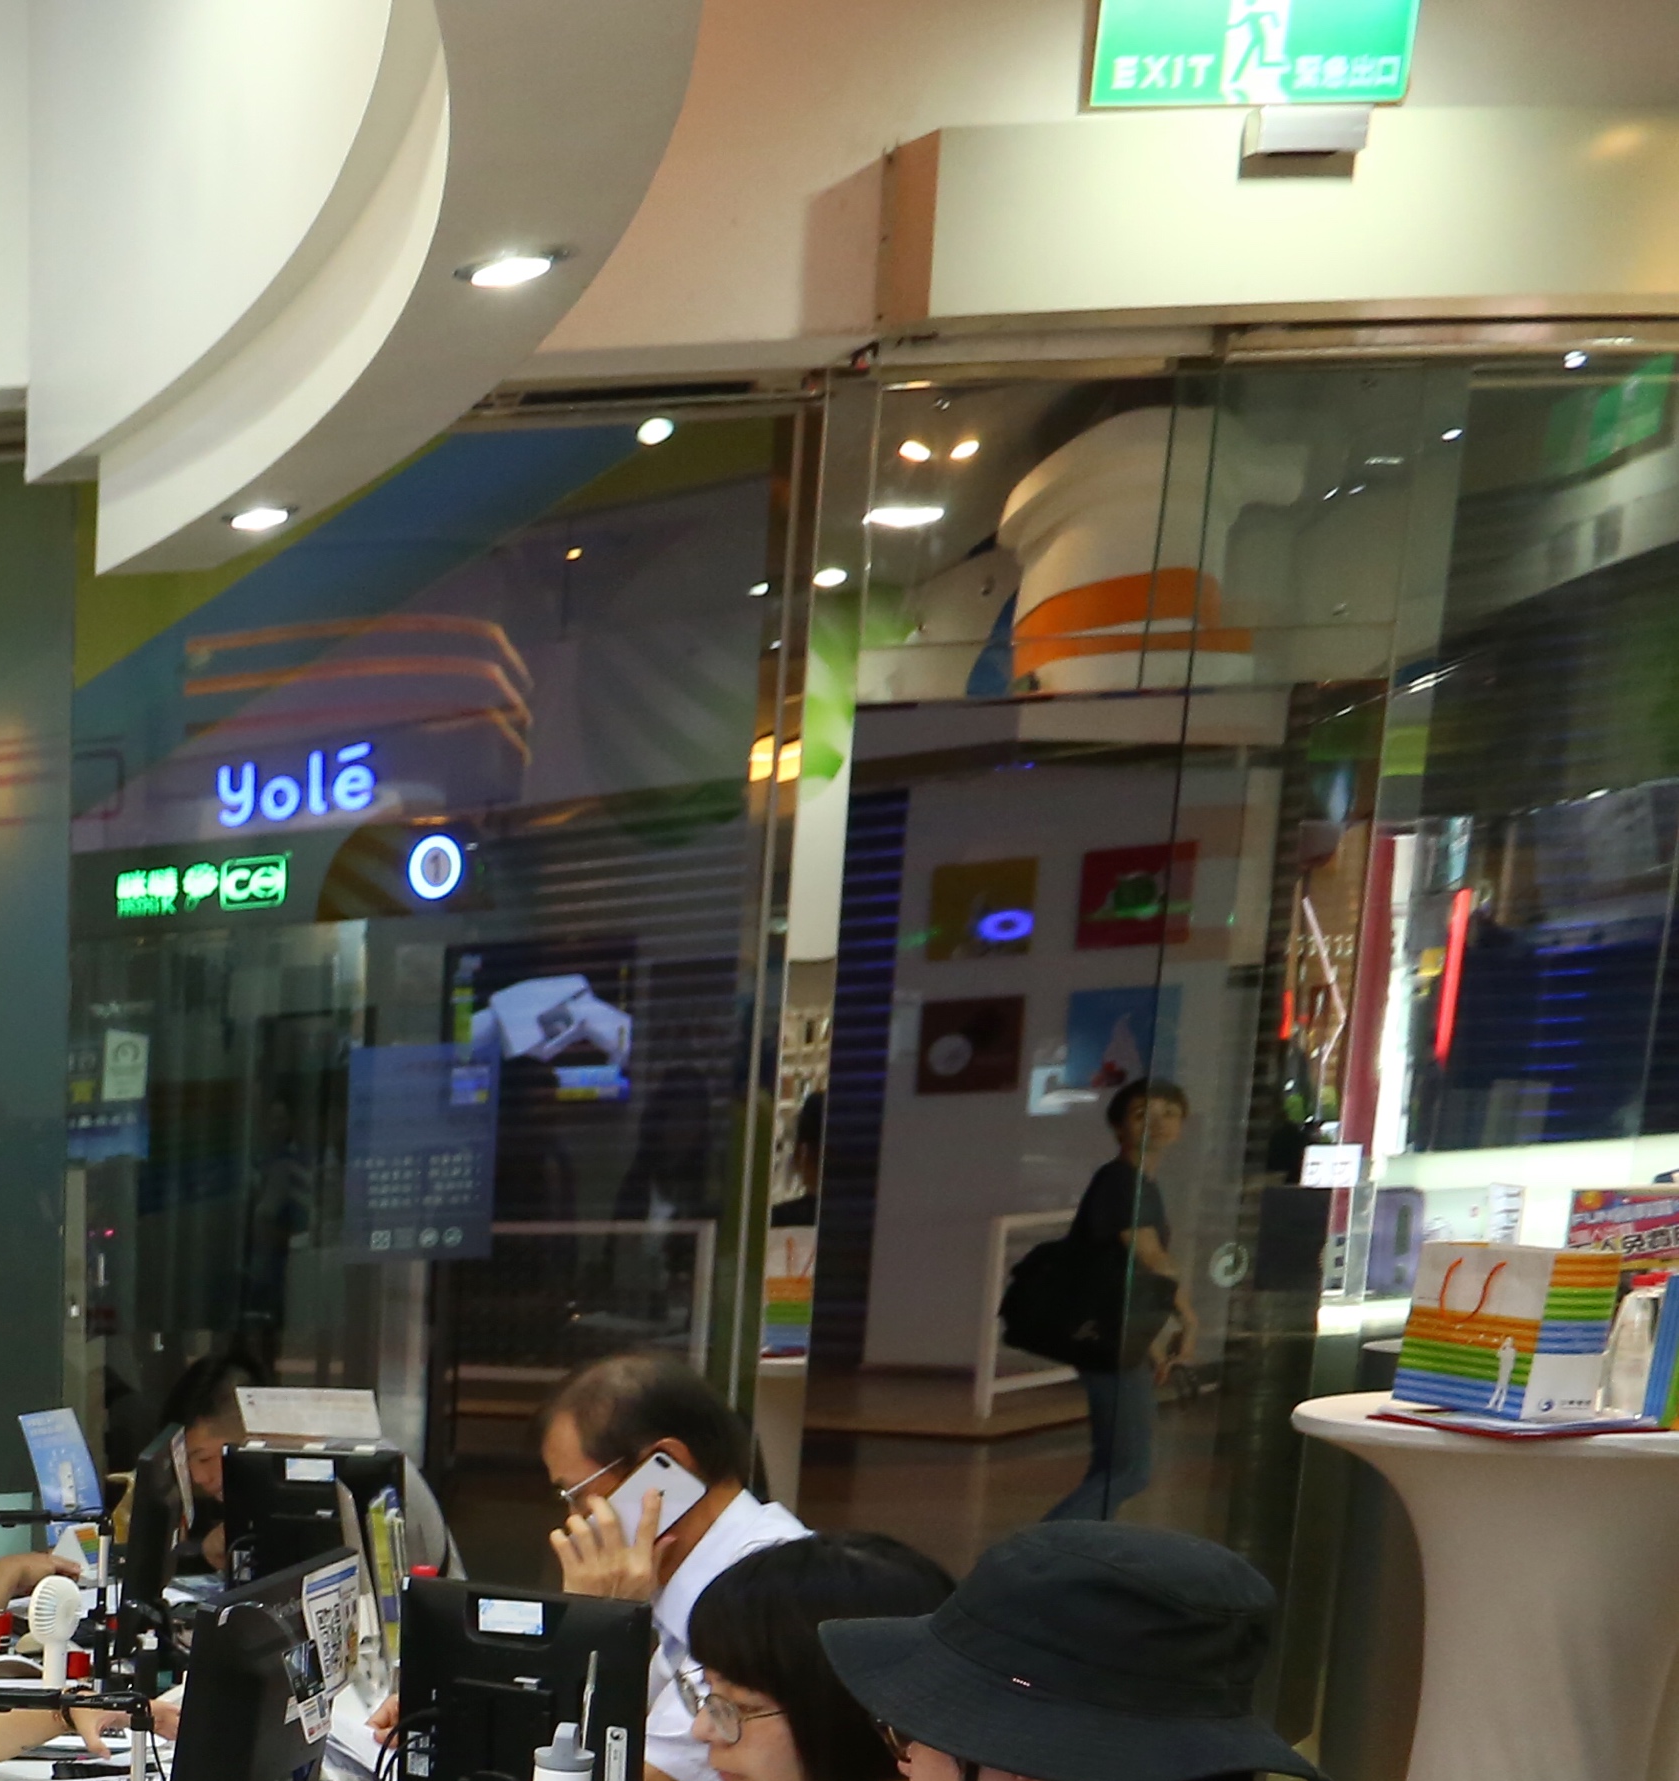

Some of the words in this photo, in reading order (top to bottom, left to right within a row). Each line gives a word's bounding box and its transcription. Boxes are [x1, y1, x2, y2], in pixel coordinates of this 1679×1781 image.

[1110, 54, 1216, 90] EXIT
[1294, 54, 1403, 90] 緊急出口
